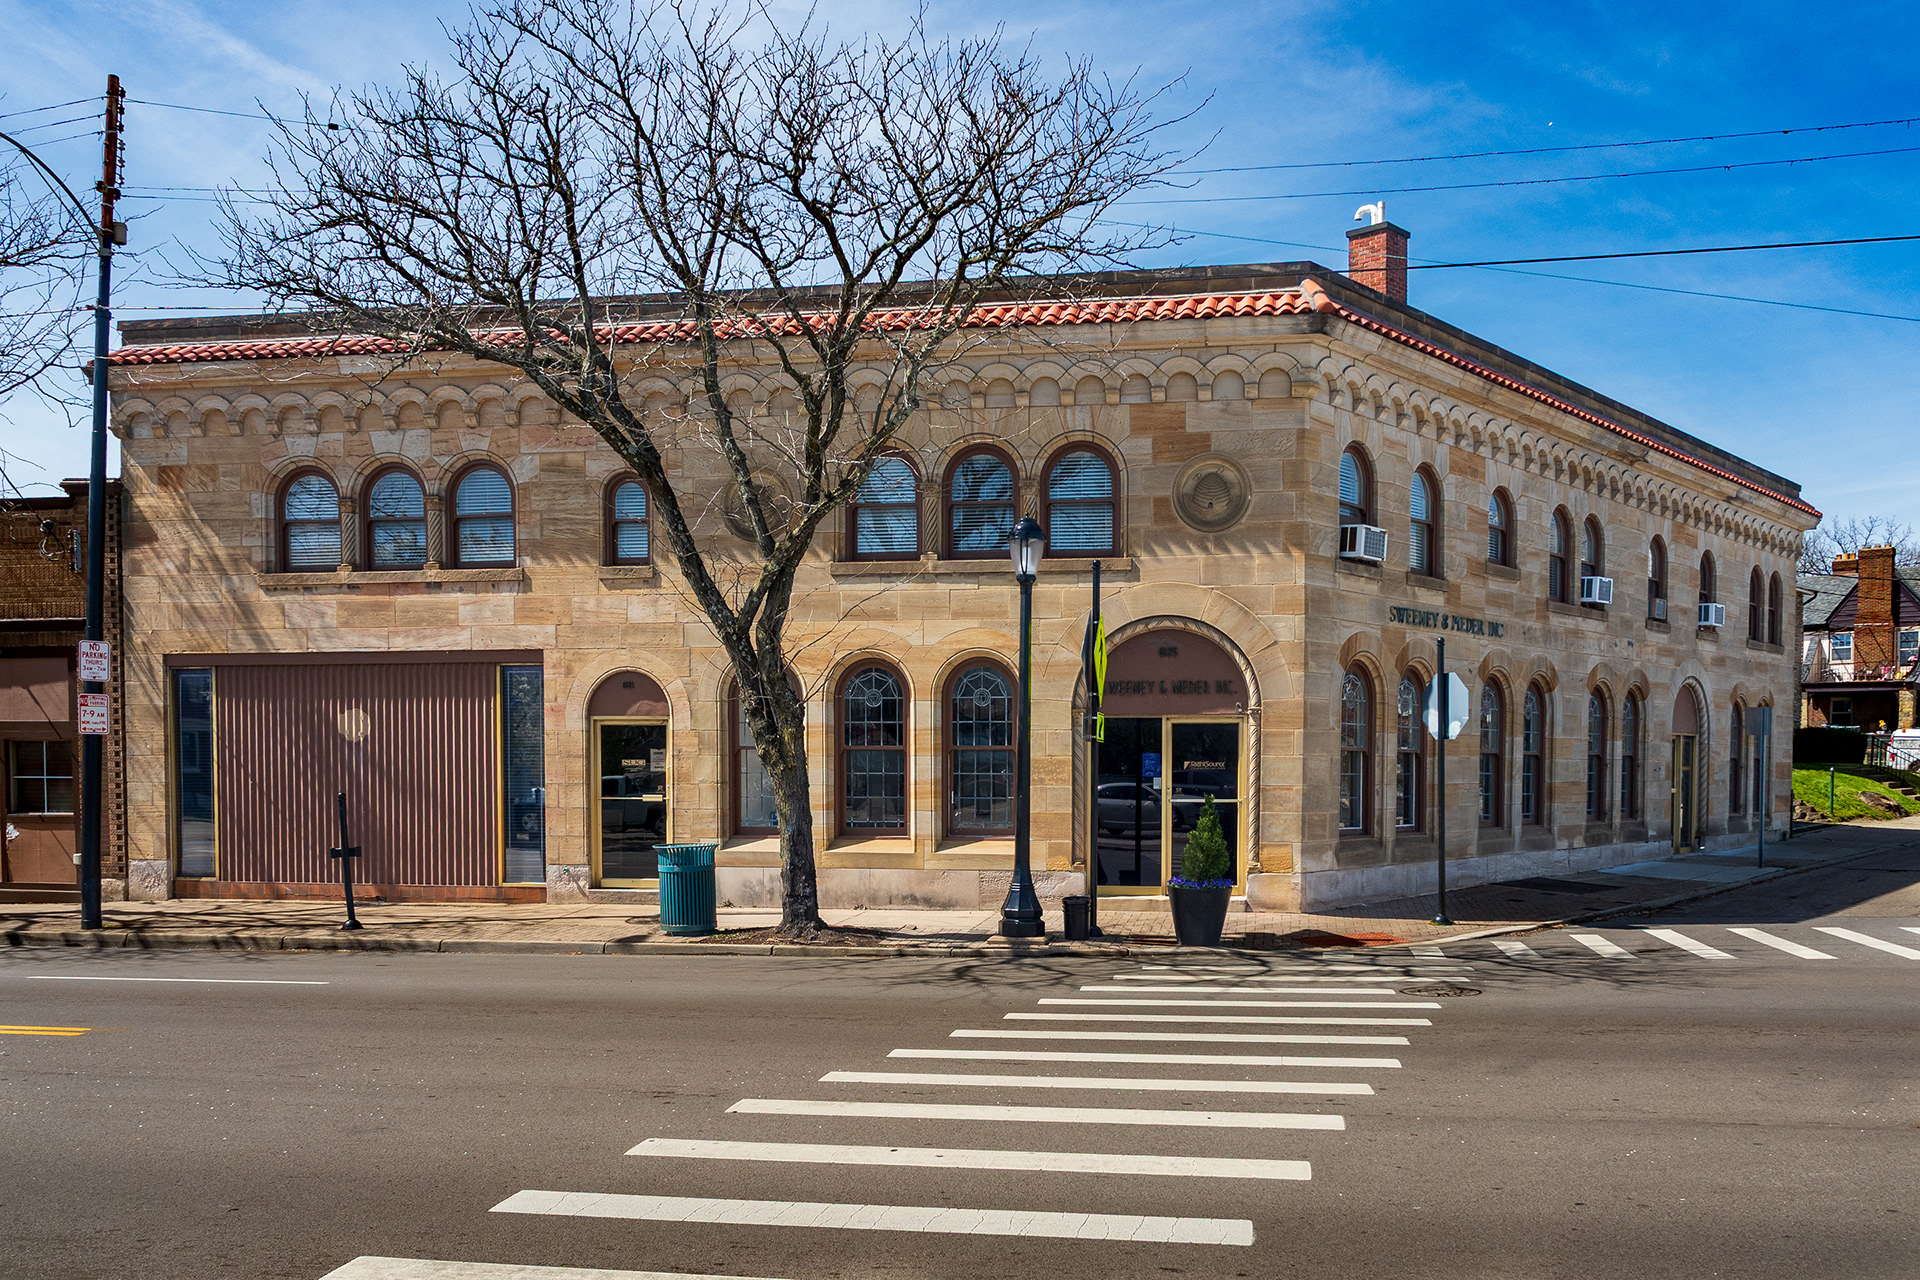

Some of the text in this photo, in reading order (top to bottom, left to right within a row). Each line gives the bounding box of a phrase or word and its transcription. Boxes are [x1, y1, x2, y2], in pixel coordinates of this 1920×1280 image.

[1390, 605, 1504, 638] SWEENEY & MEDER INC
[89, 643, 101, 652] NO
[81, 651, 107, 660] PARKING
[1105, 680, 1238, 695] WEENEY & MEDER INC.
[82, 709, 95, 718] 7-9
